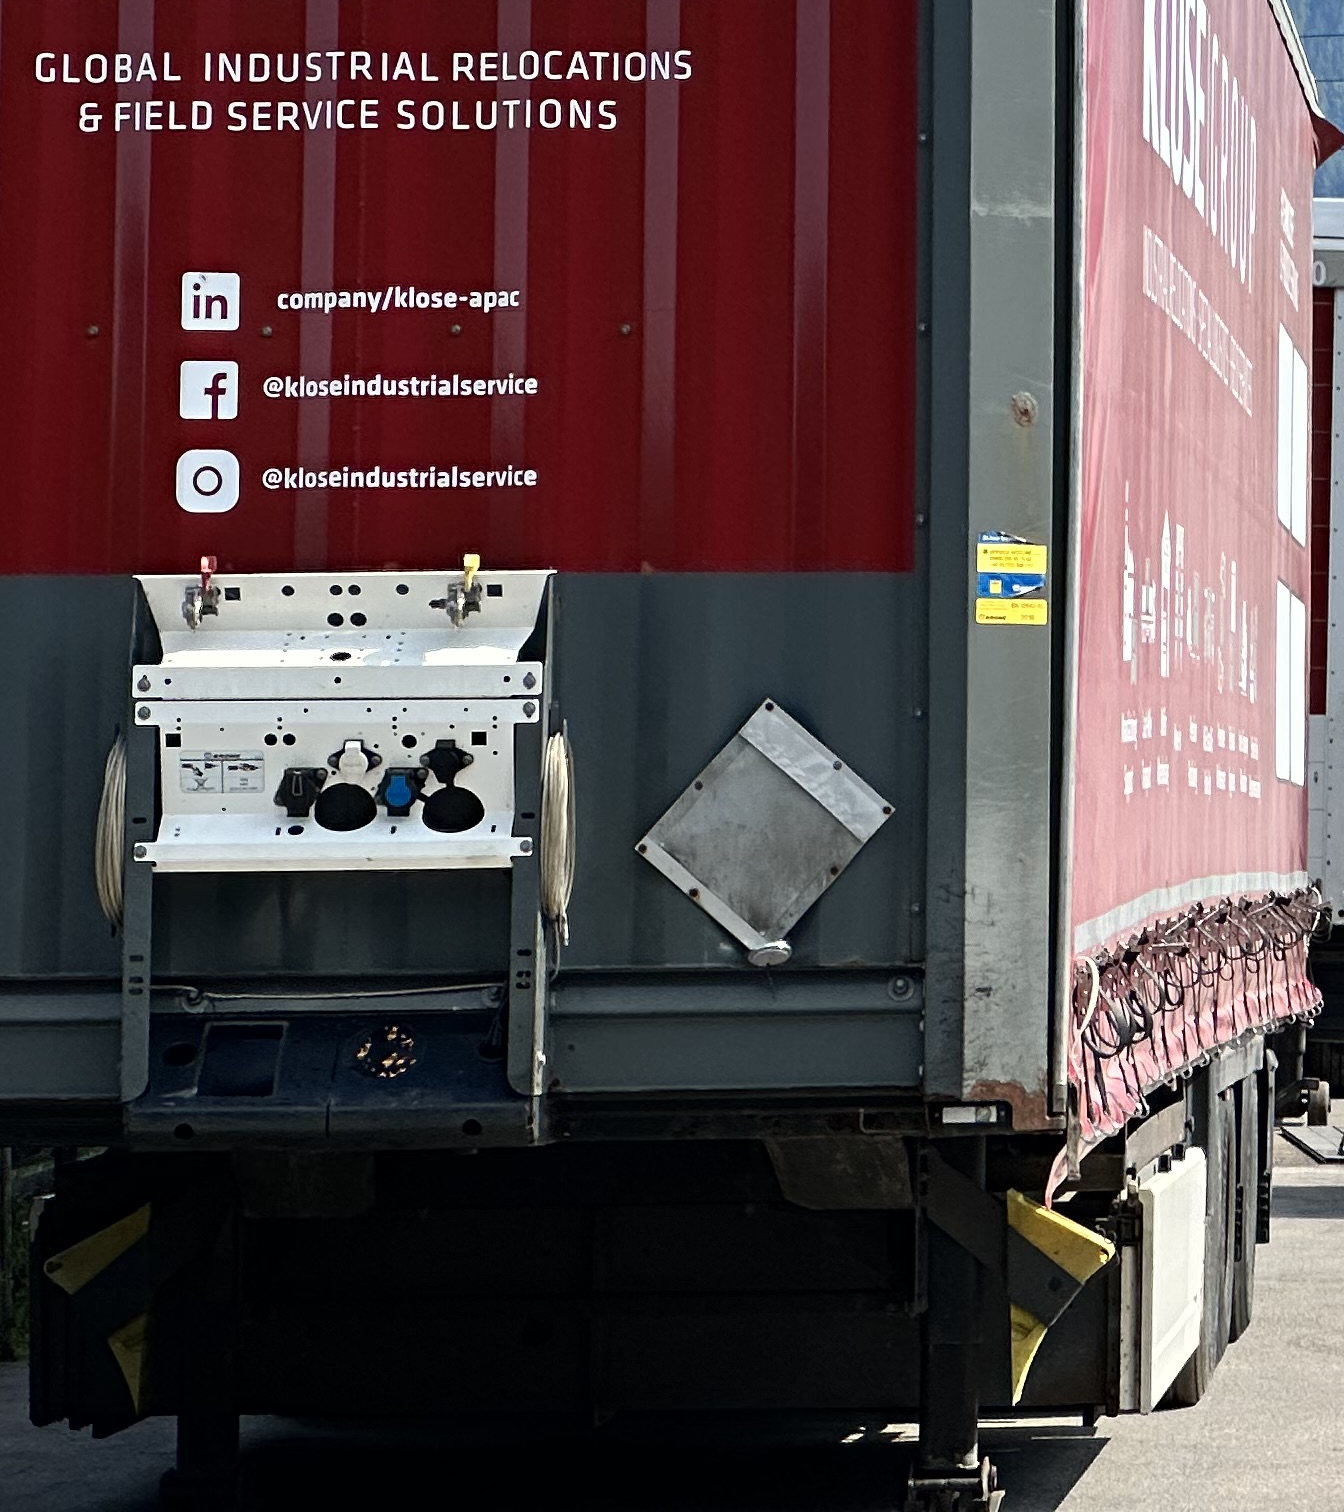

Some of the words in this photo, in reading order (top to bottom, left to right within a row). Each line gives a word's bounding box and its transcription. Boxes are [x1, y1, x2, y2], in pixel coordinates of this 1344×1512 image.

[34, 51, 182, 85] GLOBAL
[203, 51, 439, 84] INDUSTRIAL
[451, 49, 694, 82] RELOCATIONS
[78, 101, 103, 133] &
[114, 101, 213, 133] FIELD
[226, 99, 380, 132] SERVICE
[395, 98, 619, 131] SOLUTIONS
[1211, 33, 1257, 294] GROUP
[276, 286, 520, 314] company/klose-apac
[262, 373, 539, 399] @kloseindustrialservice
[261, 465, 538, 491] @kloseindustrialservice
